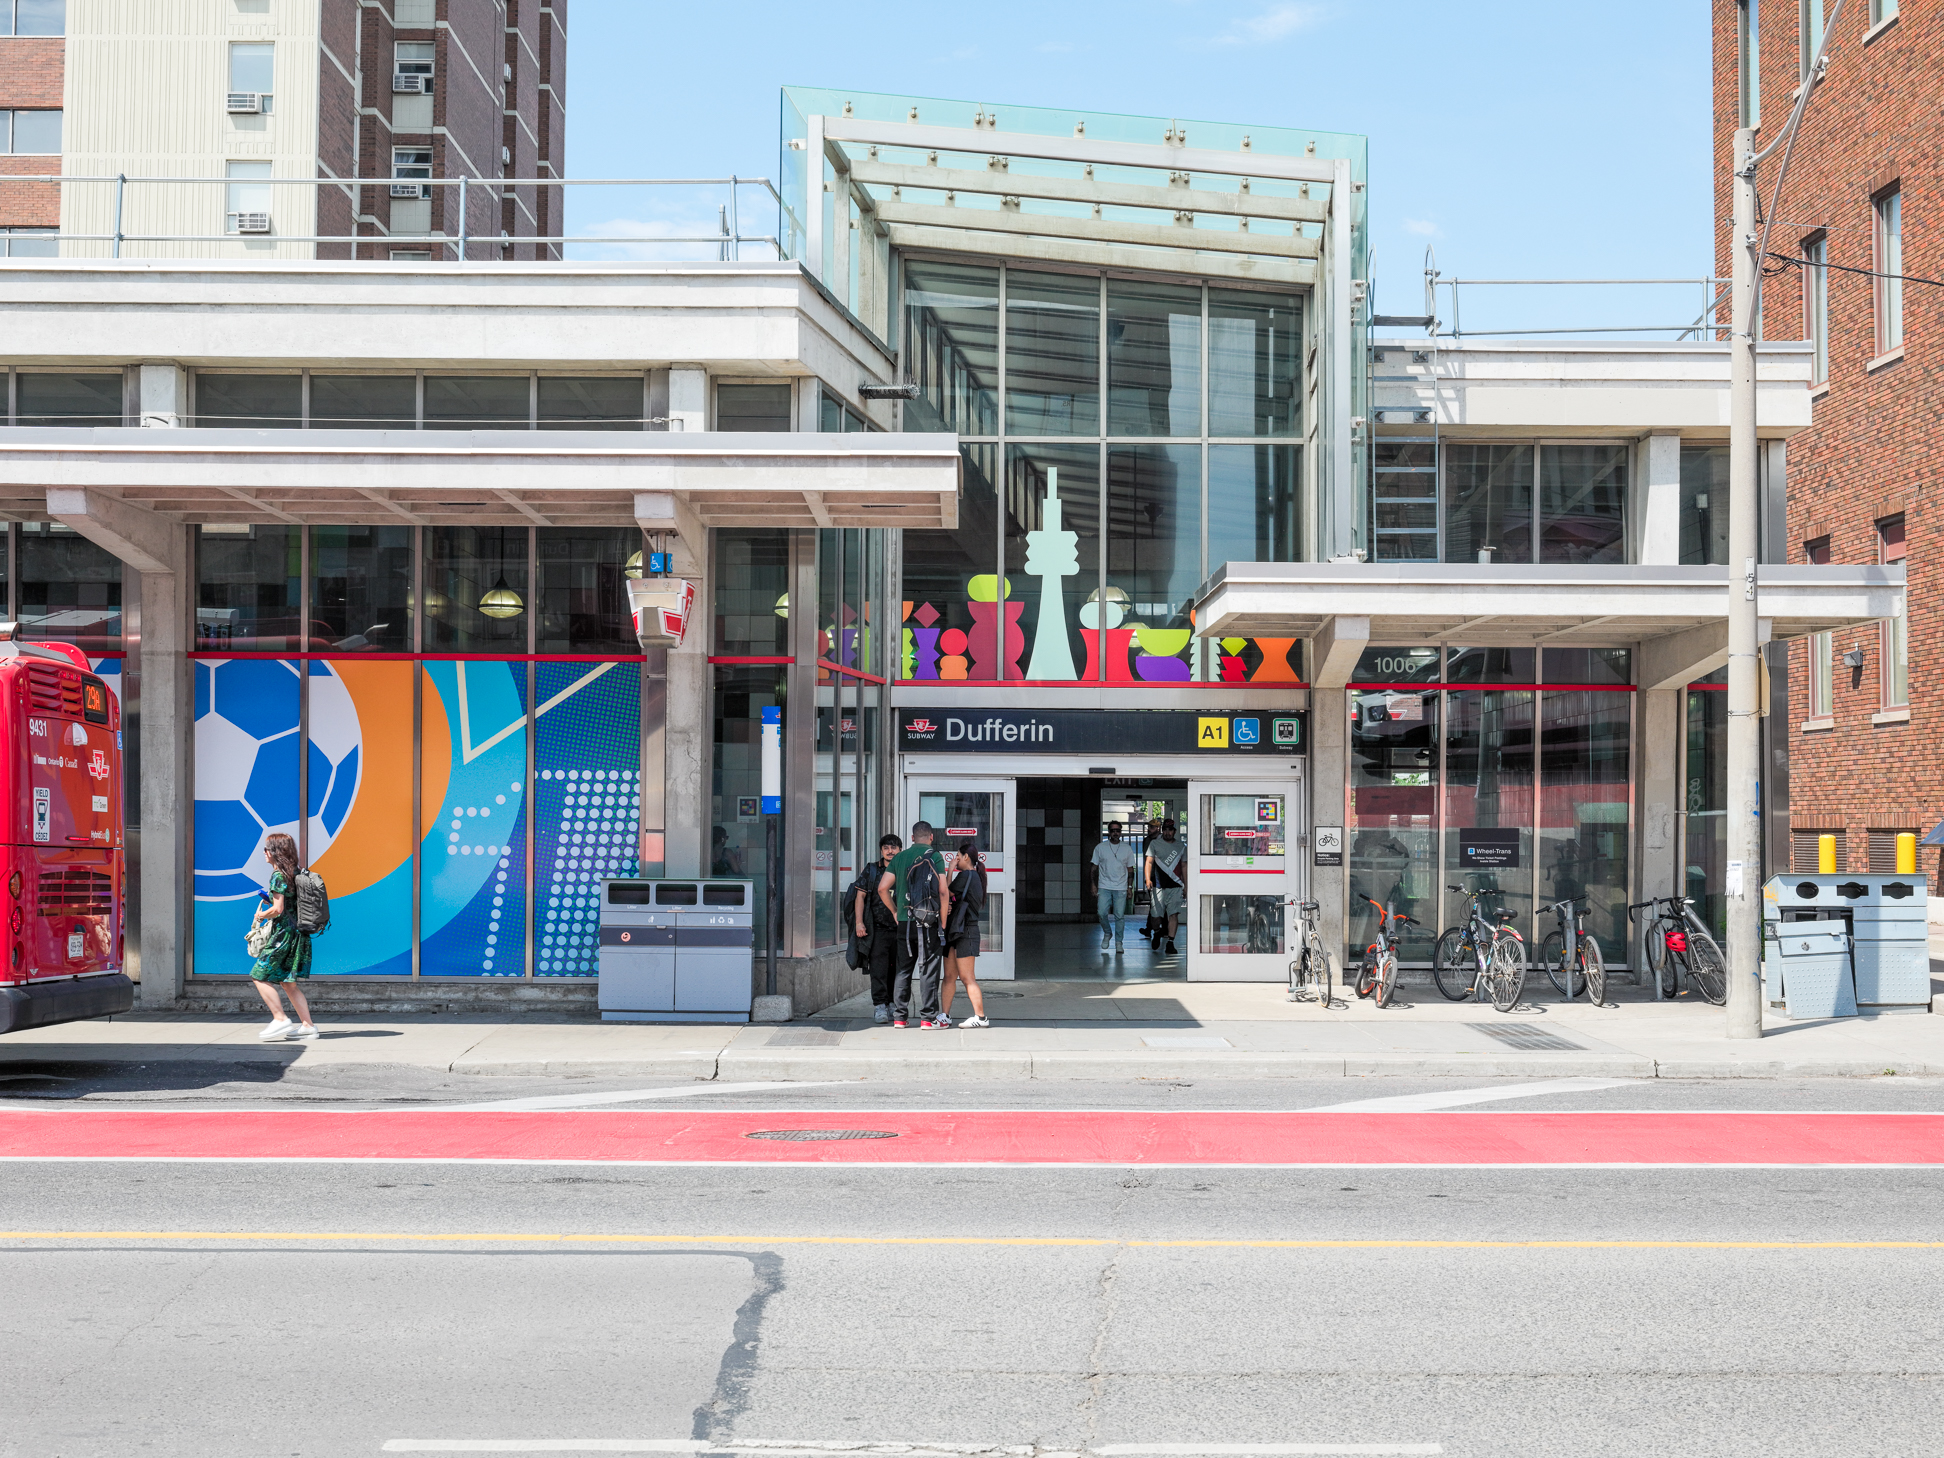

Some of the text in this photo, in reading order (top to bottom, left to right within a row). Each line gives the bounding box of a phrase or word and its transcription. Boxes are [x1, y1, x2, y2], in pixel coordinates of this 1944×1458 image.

[1374, 657, 1416, 673] 1006
[85, 685, 101, 710] 29A
[29, 718, 47, 737] 9431
[946, 718, 1054, 741] Dufferin
[1202, 725, 1222, 740] A1
[35, 789, 48, 798] YIELD
[35, 830, 48, 840] CÉDEZ
